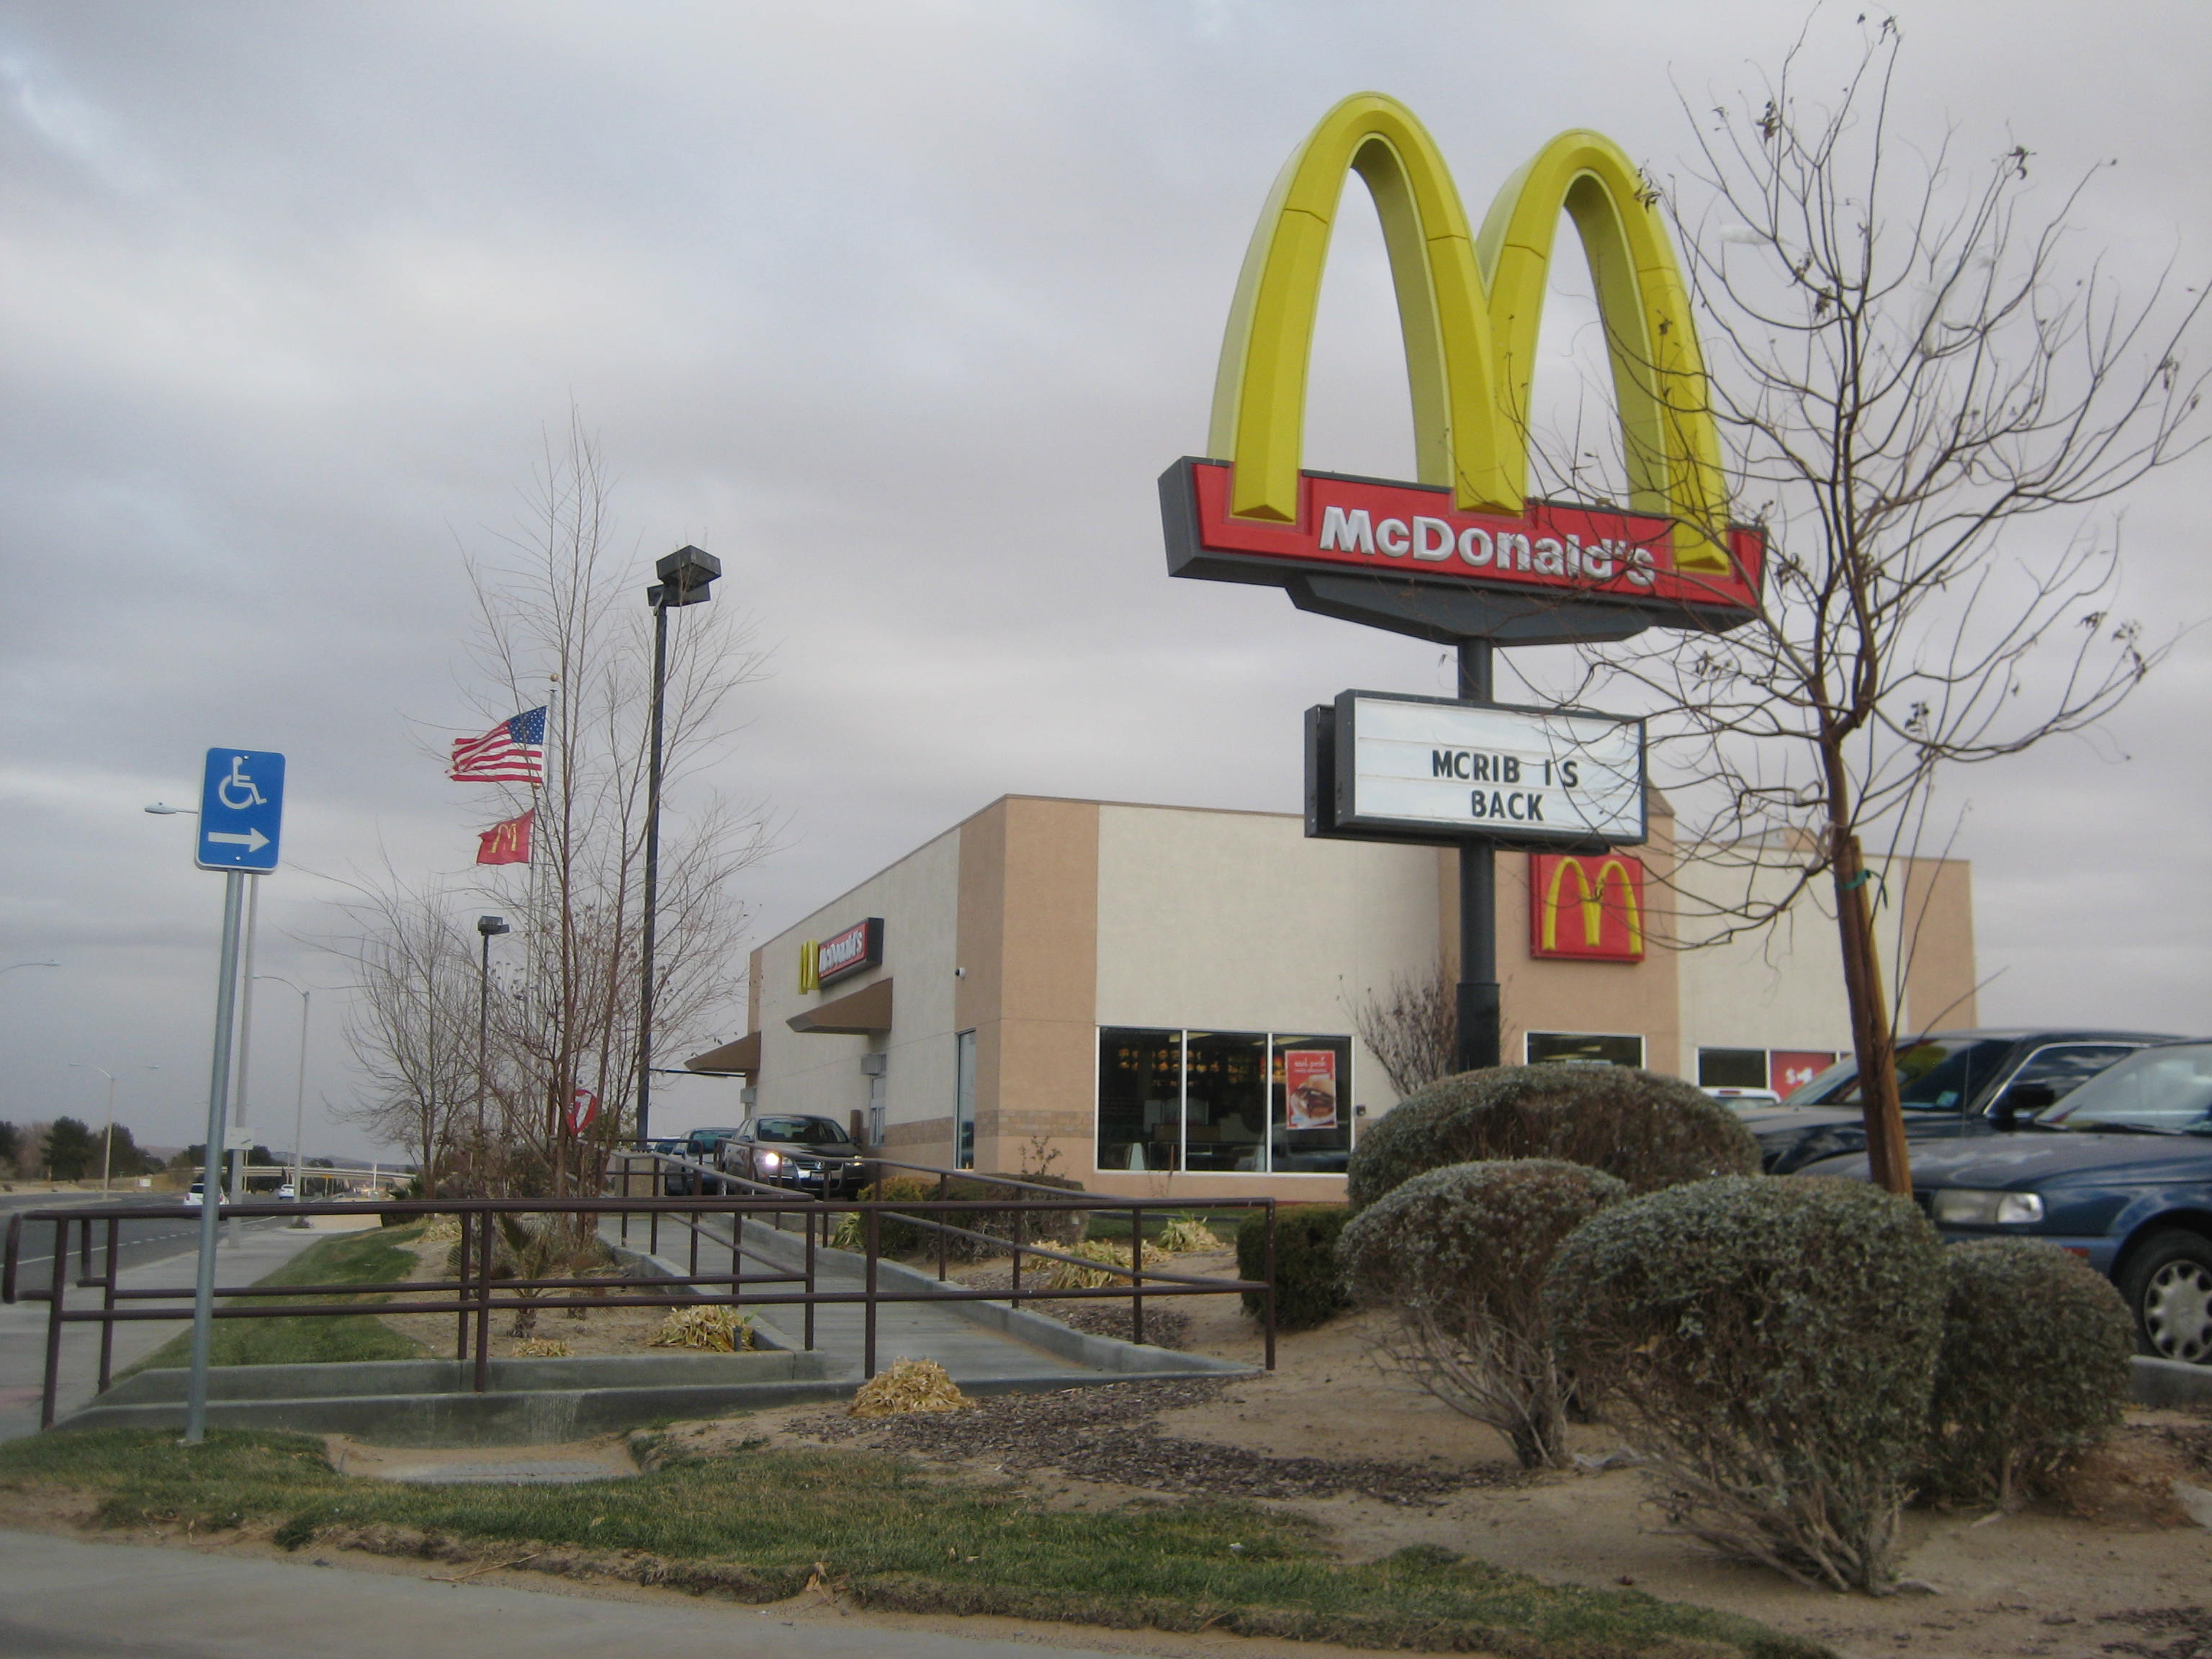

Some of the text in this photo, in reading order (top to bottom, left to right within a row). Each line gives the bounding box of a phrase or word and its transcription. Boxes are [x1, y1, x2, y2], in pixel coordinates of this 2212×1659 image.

[1318, 505, 1656, 587] McDonald's
[1431, 750, 1579, 788] MCRIB IS
[1472, 789, 1545, 822] BACK
